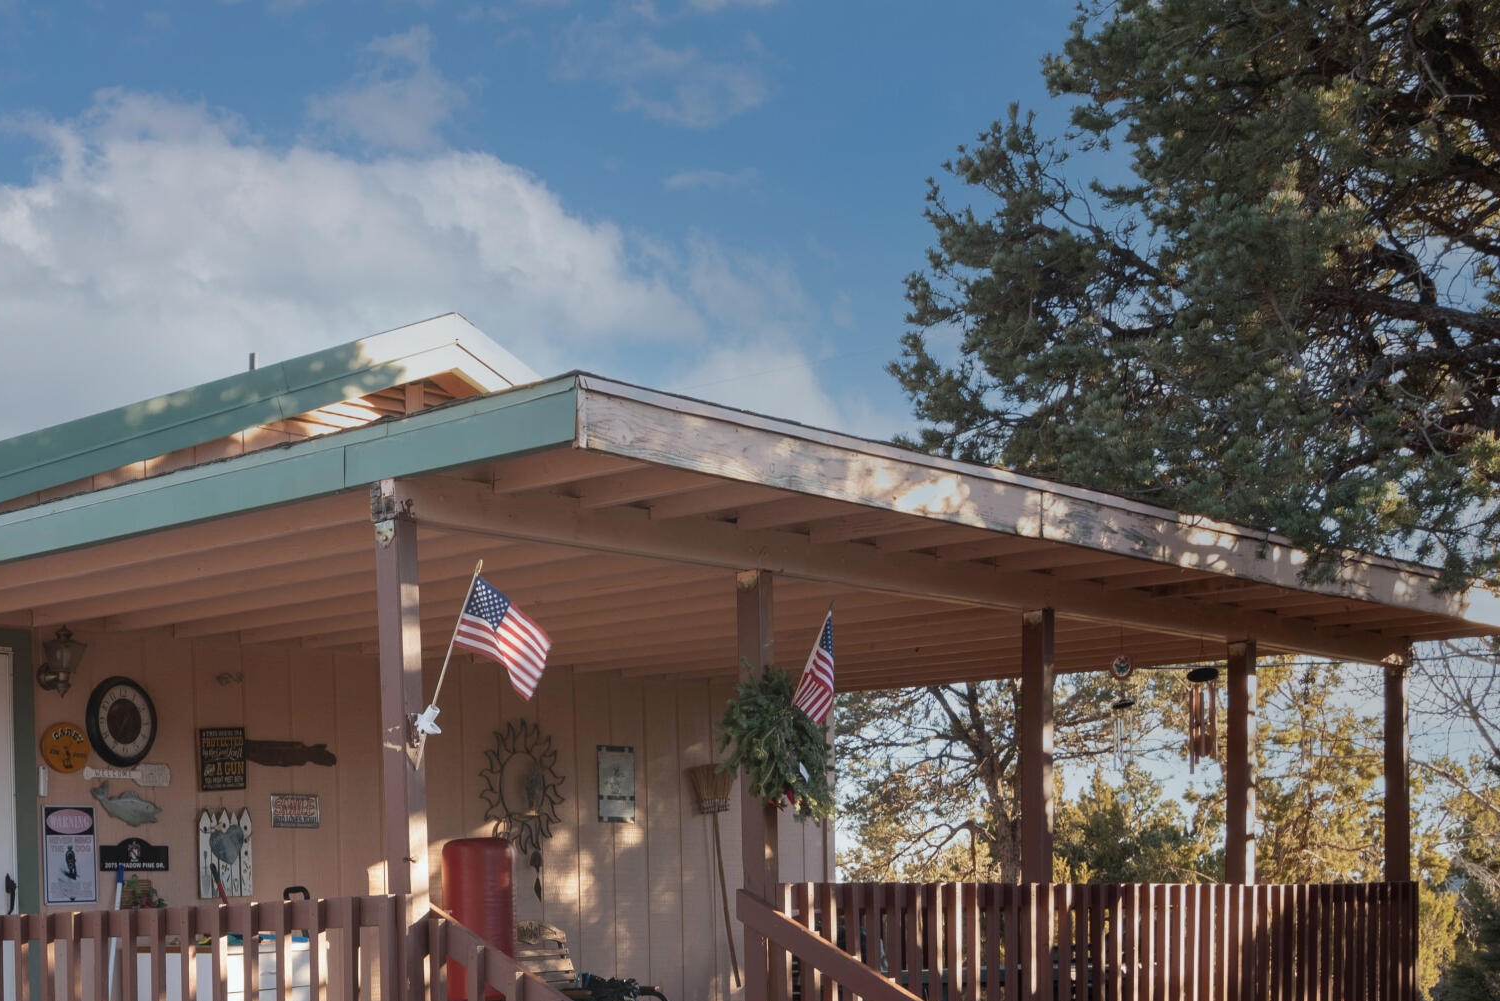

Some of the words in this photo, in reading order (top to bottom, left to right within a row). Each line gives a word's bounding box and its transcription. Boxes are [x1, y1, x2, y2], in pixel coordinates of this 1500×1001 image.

[202, 736, 244, 747] PROTECTED
[94, 769, 132, 777] WELCOME
[217, 762, 222, 776] A
[224, 761, 244, 776] GUN
[274, 798, 316, 816] SMILE
[50, 815, 89, 828] WARNING
